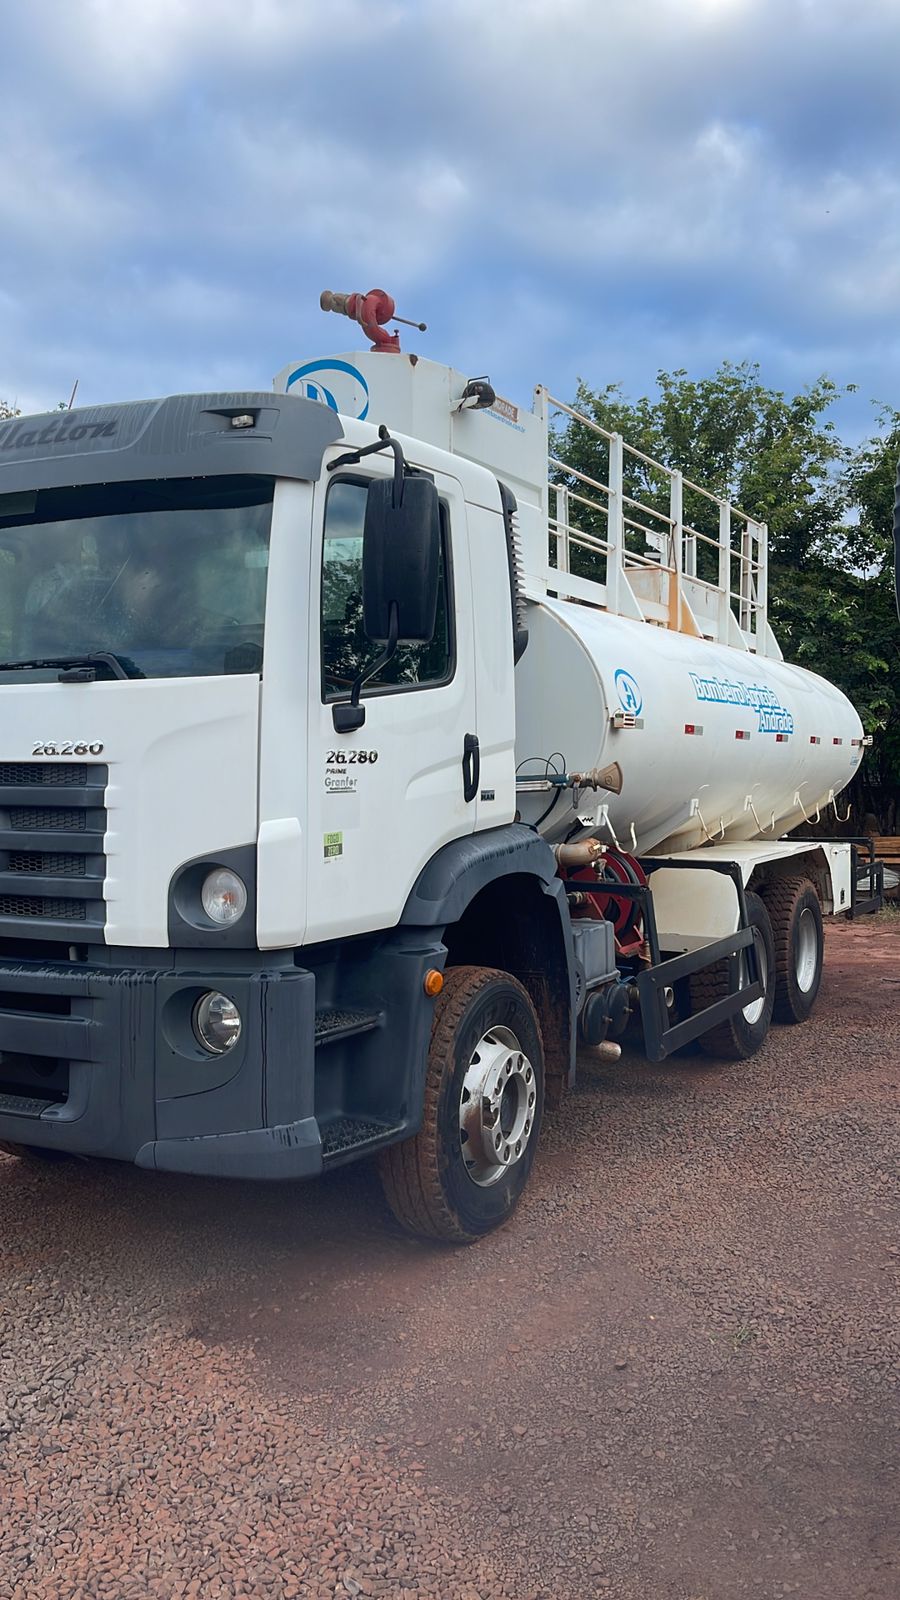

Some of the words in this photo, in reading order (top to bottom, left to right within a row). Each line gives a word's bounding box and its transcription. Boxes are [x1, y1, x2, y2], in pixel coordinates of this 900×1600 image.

[758, 708, 793, 734] Andrade
[32, 740, 104, 756] 26.280
[326, 750, 378, 764] 26.280
